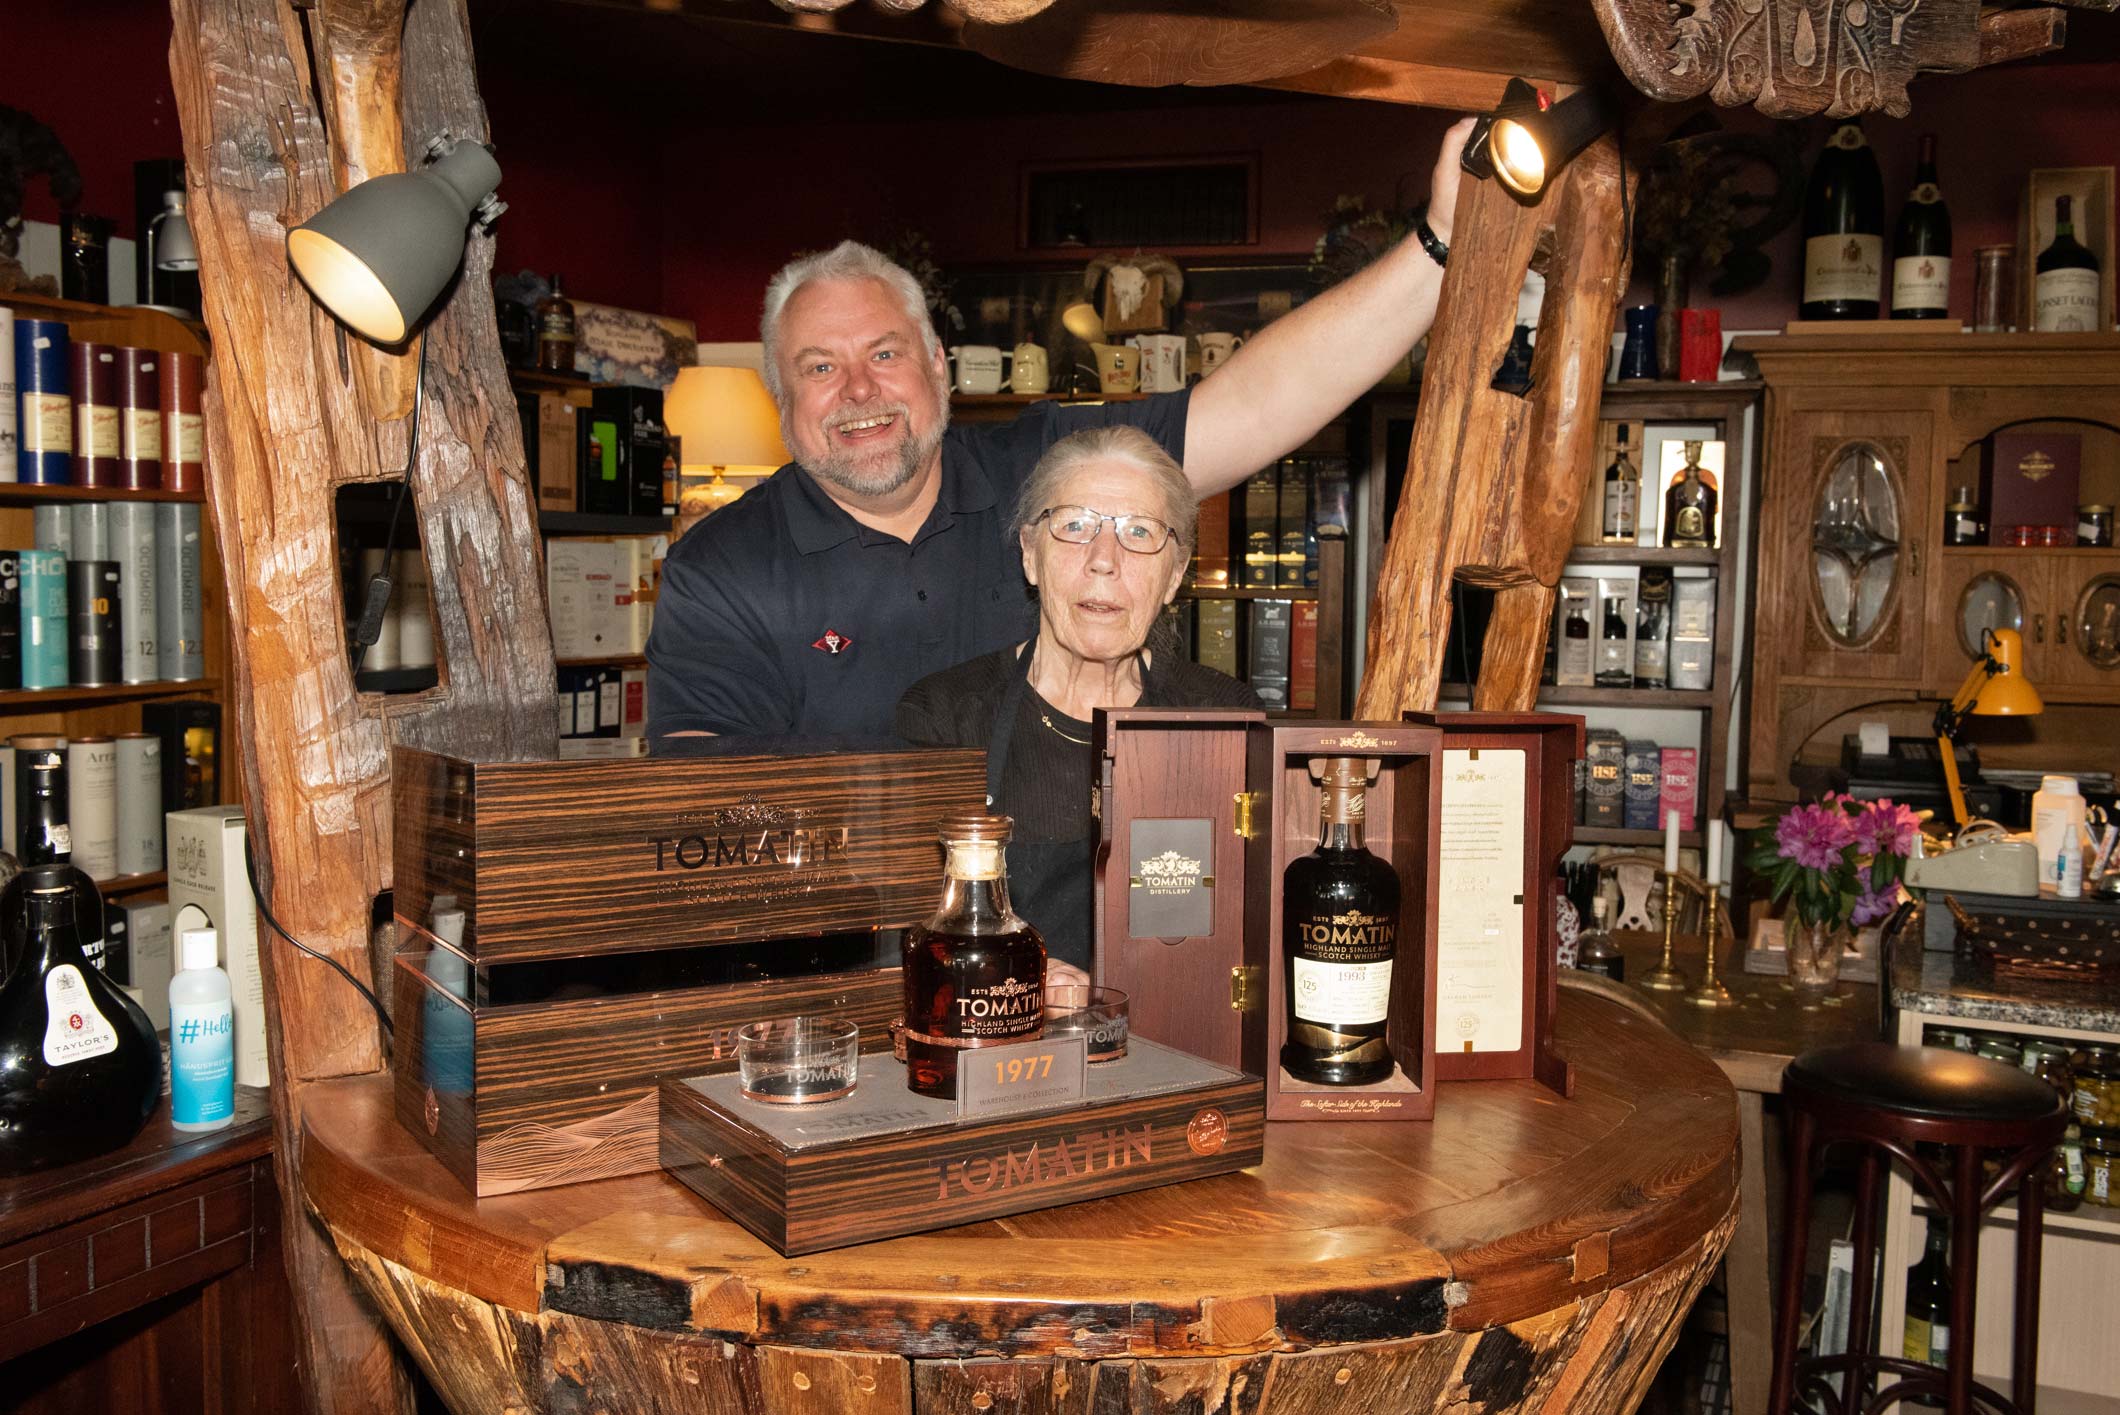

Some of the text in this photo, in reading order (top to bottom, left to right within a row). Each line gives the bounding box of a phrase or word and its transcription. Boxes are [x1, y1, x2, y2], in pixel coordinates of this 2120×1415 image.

[139, 545, 152, 615] OCTOMORE
[182, 546, 194, 615] OCTOMORE
[92, 598, 109, 615] 10
[1593, 765, 1617, 779] HSE
[1632, 773, 1654, 785] HSE
[1665, 774, 1688, 786] HSE
[646, 826, 849, 872] TOMATIN
[1145, 876, 1196, 886] TOMATIN
[1299, 923, 1395, 945] TOMATIN
[1304, 943, 1347, 953] HIGHLAND
[1318, 951, 1380, 960] SCOTCH WHISKY
[1337, 970, 1366, 982] 1993
[1303, 979, 1317, 991] 125
[956, 991, 1044, 1017] TOMATIN
[961, 1020, 1004, 1028] HIGHLAND
[1006, 1015, 1029, 1026] SINGLE
[976, 1021, 1034, 1035] SCOTCH WHISKY
[54, 1034, 110, 1053] TAYLOR'S
[995, 1054, 1055, 1084] 1977
[1028, 1087, 1070, 1098] COLLECTION
[928, 1123, 1153, 1200] TOMATIN
